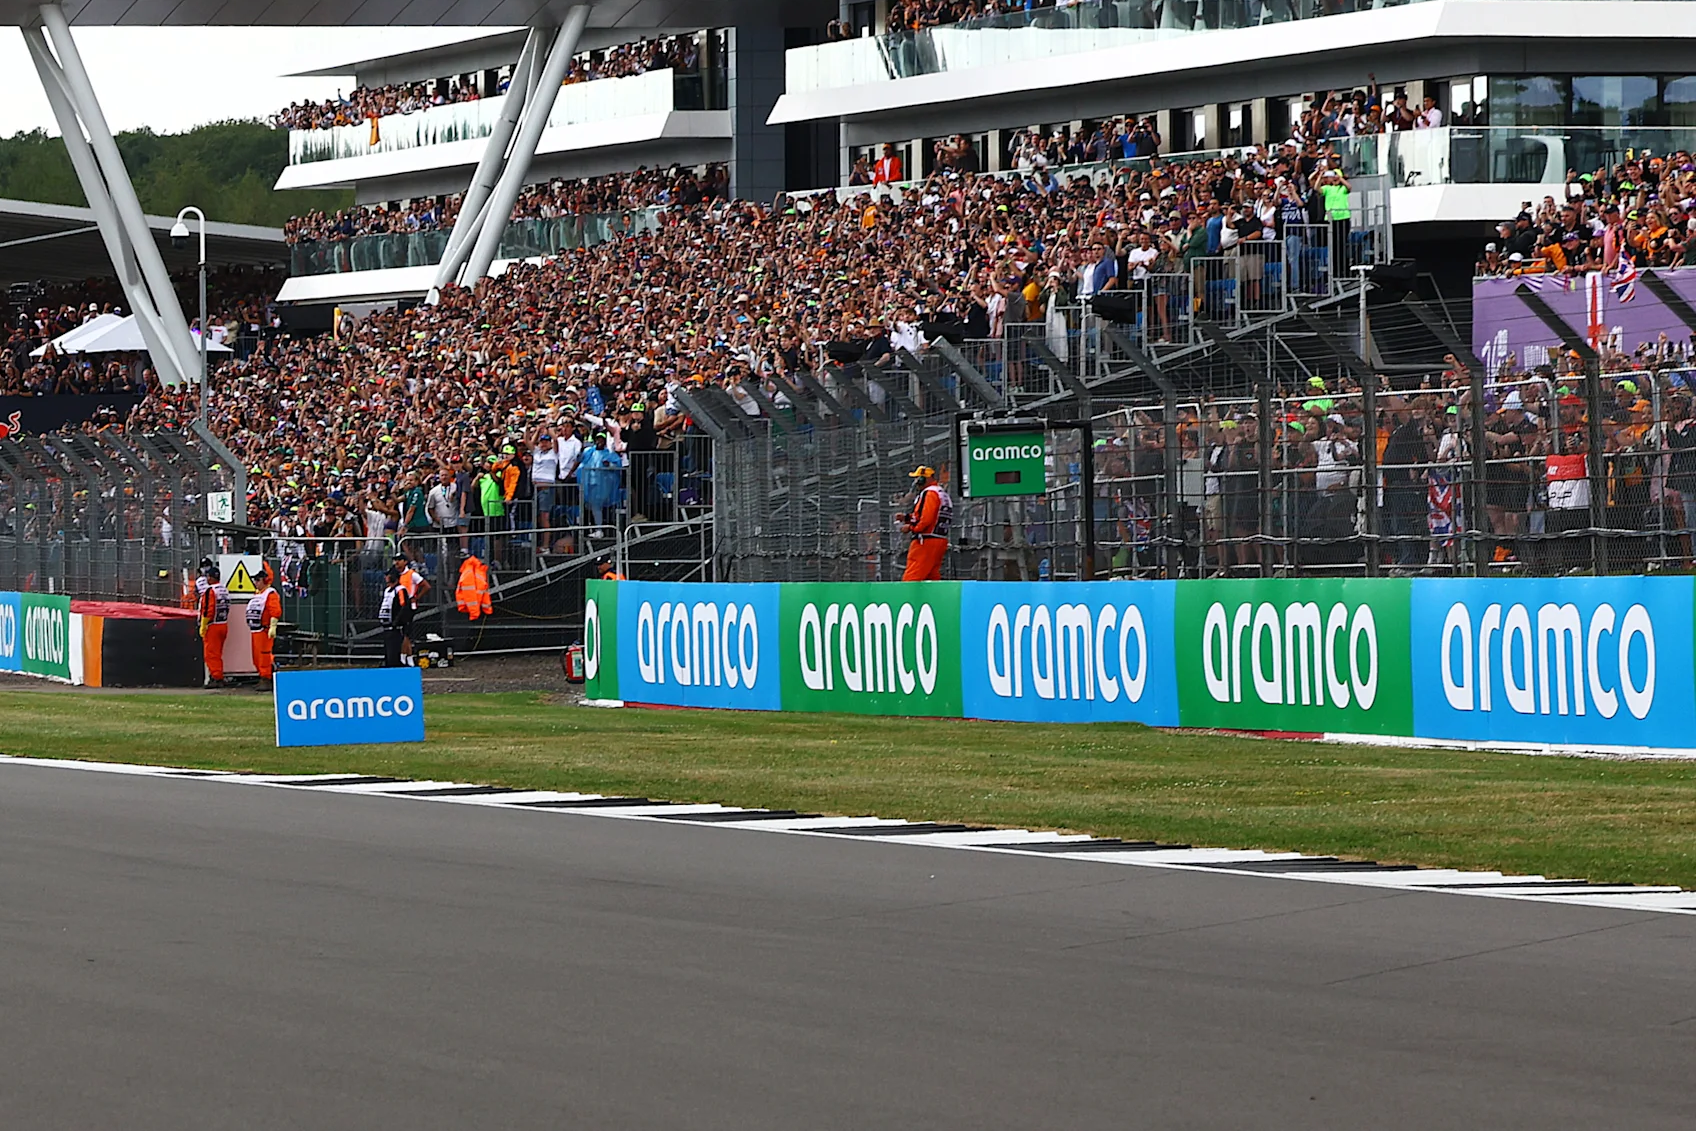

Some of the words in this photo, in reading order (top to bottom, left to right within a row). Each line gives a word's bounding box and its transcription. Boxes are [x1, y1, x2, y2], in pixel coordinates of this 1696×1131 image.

[972, 444, 1042, 461] aramco
[637, 601, 759, 689] aramco
[799, 602, 938, 695] aramco
[987, 602, 1148, 703] aramco
[1202, 600, 1379, 710] aramco
[1440, 601, 1656, 720] aramco
[287, 695, 414, 721] aramco
